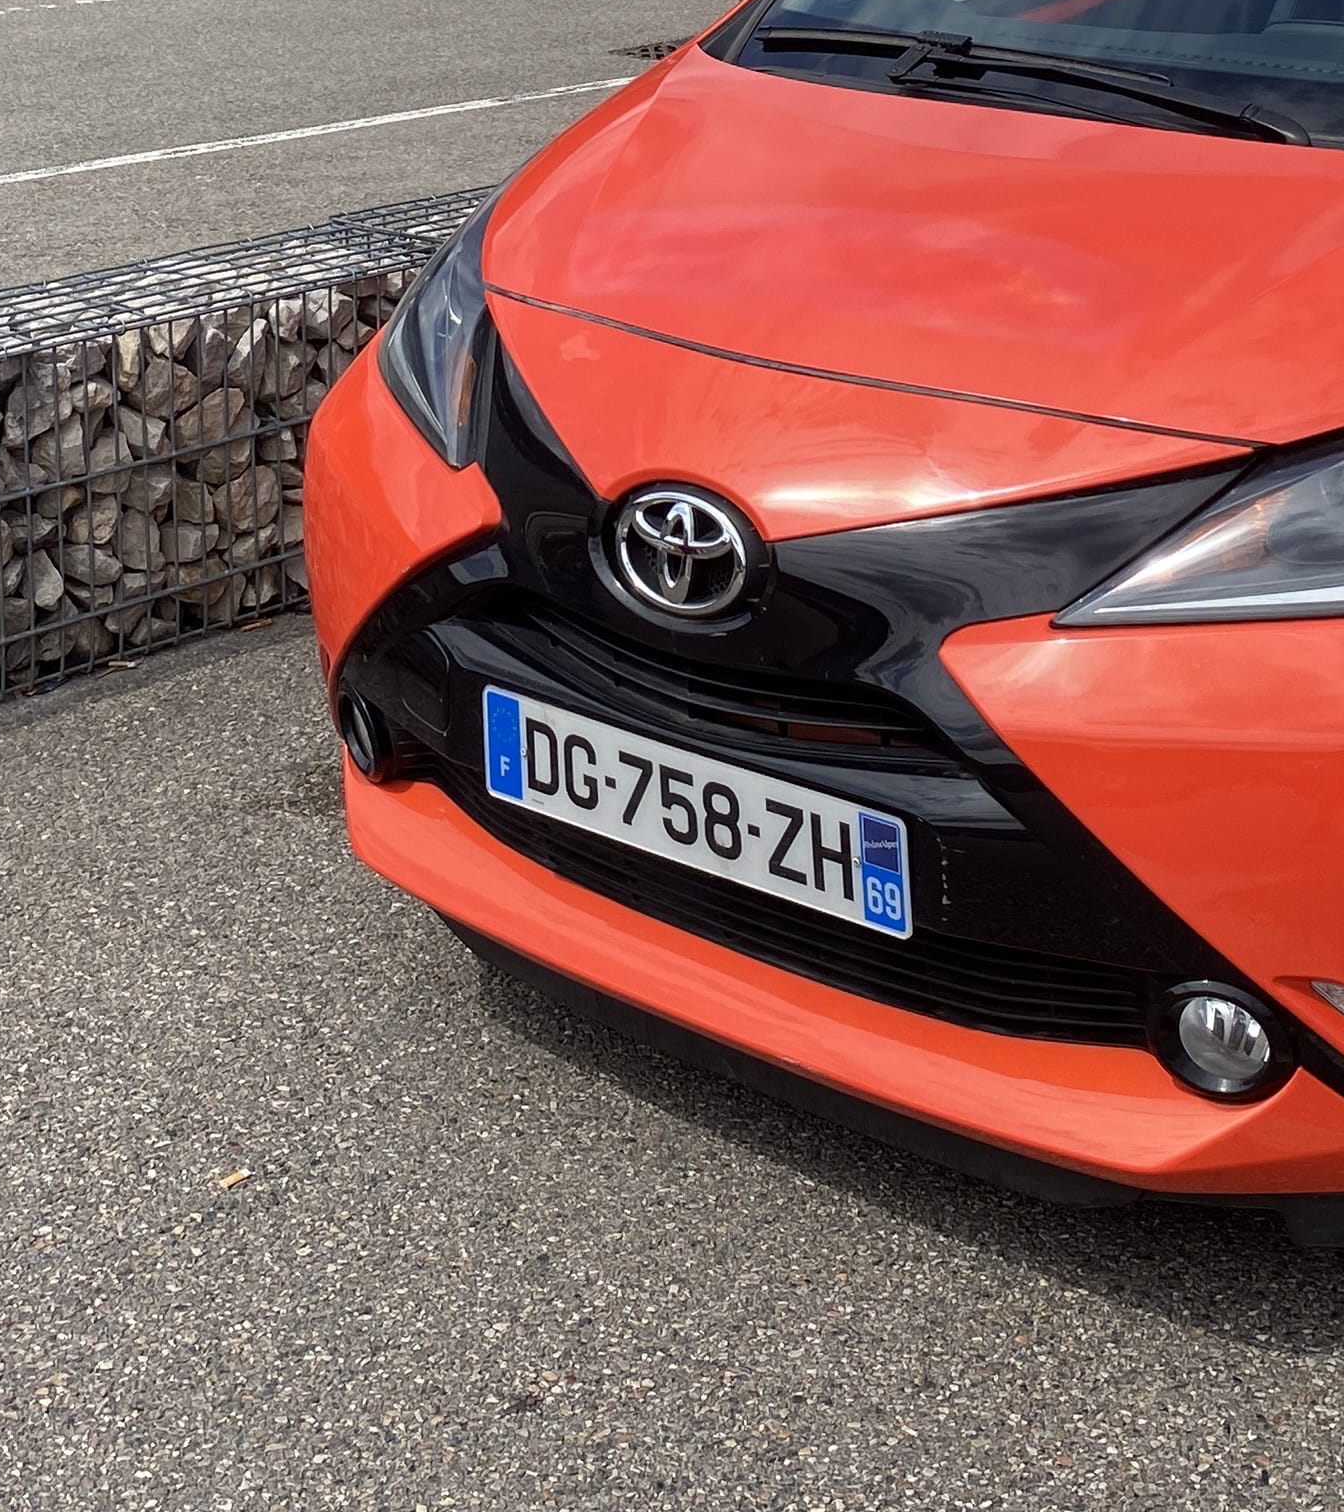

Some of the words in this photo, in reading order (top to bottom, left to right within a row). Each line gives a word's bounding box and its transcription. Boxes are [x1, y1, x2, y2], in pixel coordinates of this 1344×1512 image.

[499, 755, 510, 777] F
[526, 716, 855, 902] DG-758-ZH
[866, 875, 902, 921] 69
